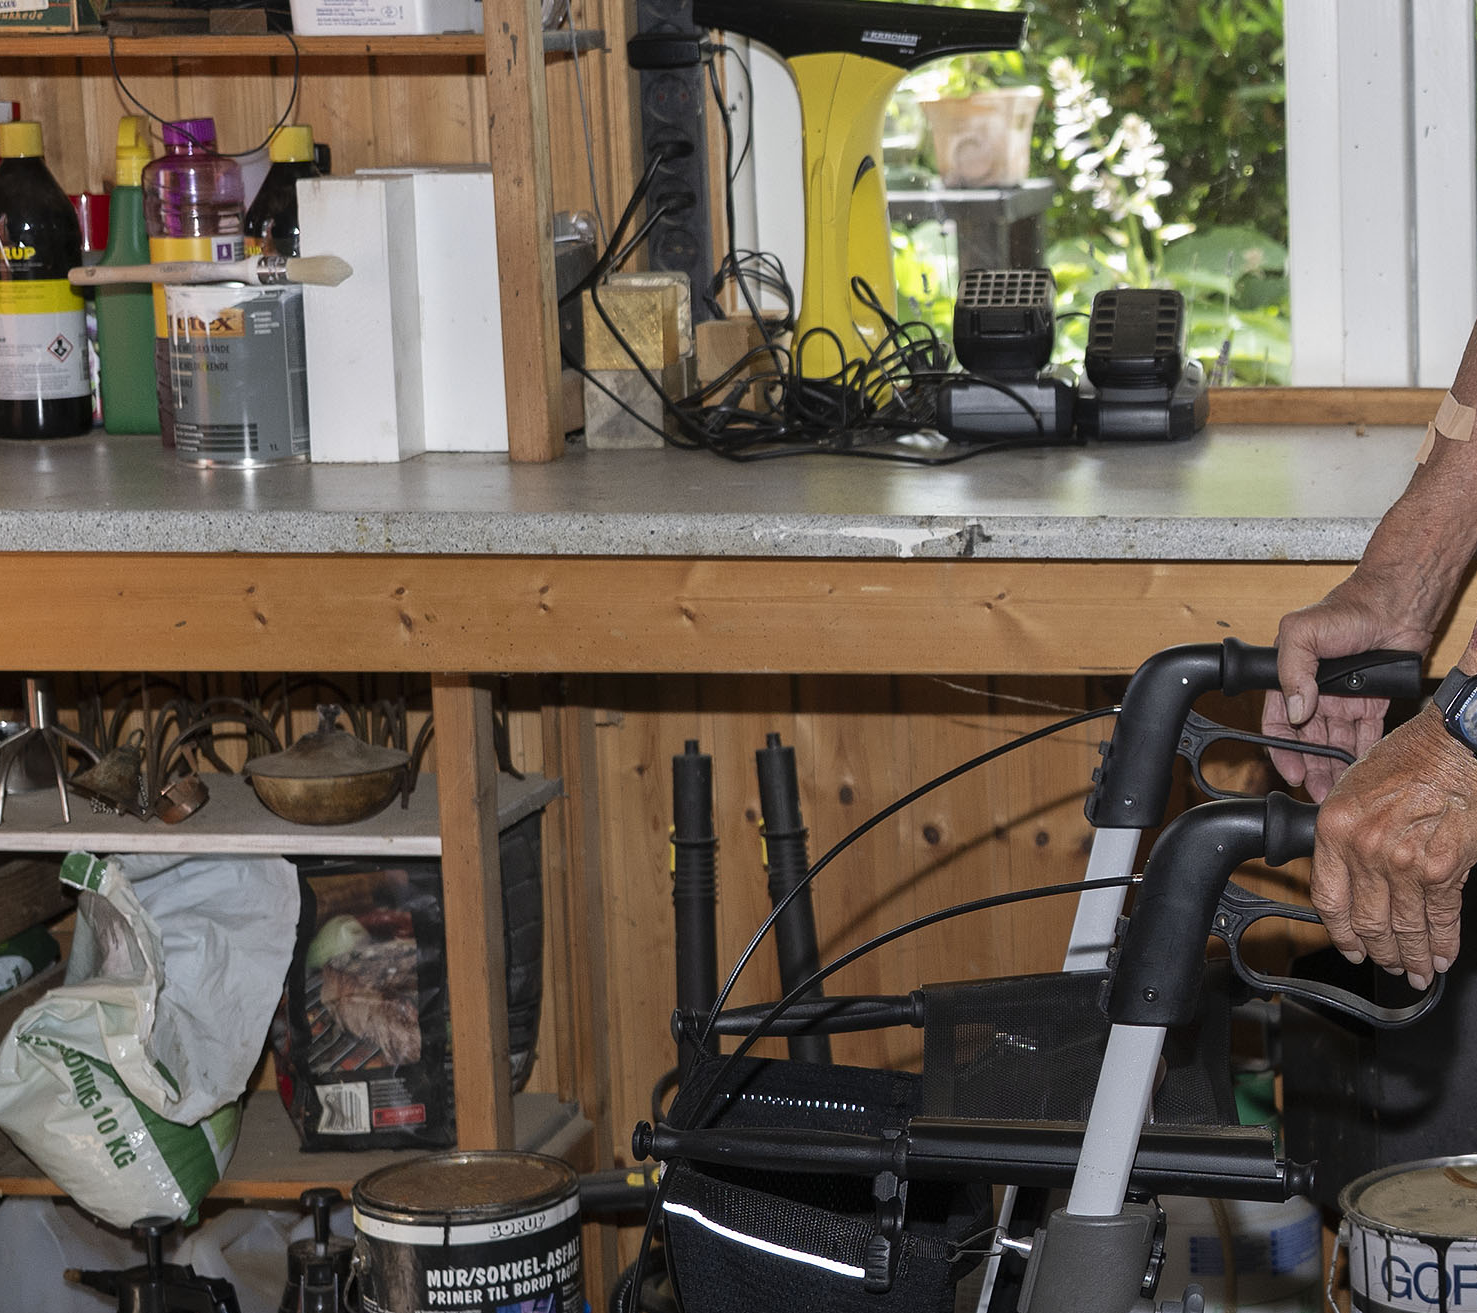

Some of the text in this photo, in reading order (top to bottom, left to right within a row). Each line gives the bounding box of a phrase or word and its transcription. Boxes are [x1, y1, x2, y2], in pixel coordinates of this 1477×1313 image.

[92, 1105, 119, 1136] 10
[105, 1133, 138, 1170] KG
[489, 1214, 546, 1239] BORUP
[428, 1288, 483, 1305] PRIMER
[487, 1285, 509, 1302] TIL
[513, 1273, 554, 1298] BORUP
